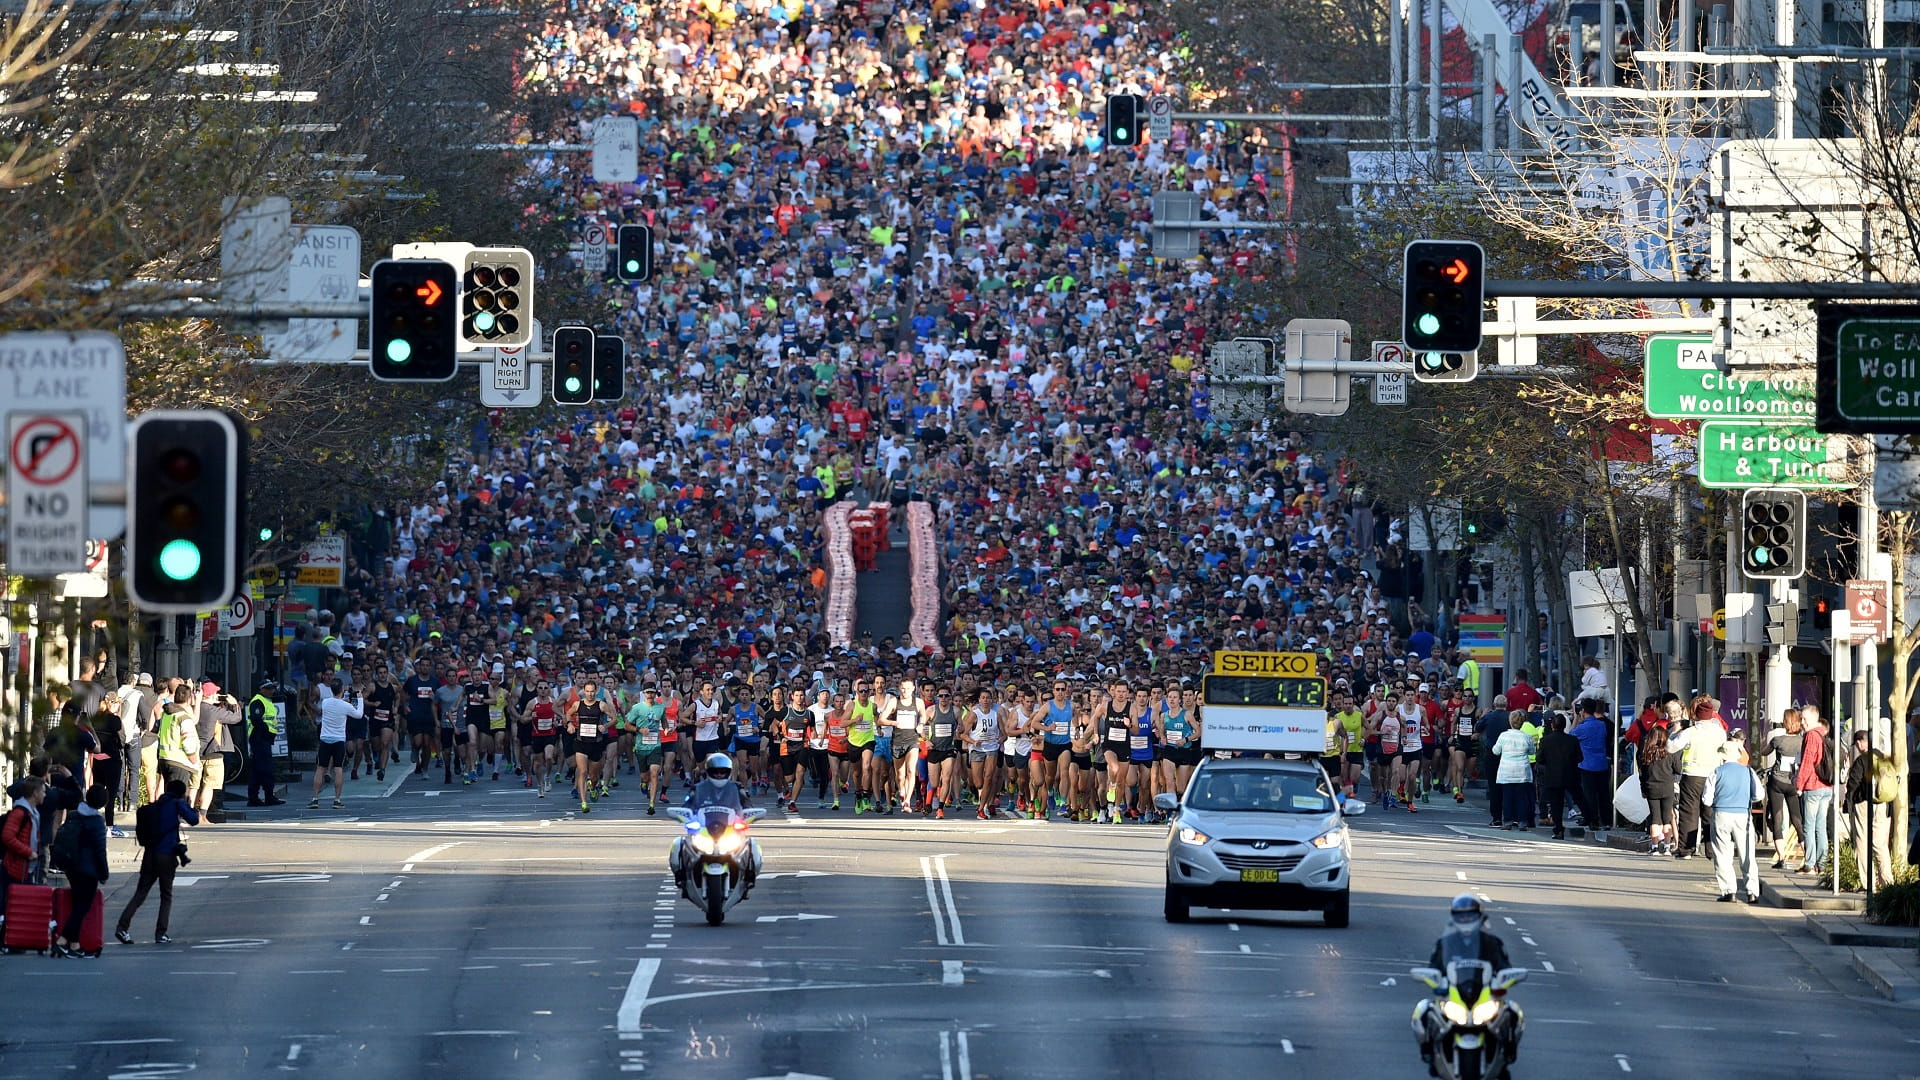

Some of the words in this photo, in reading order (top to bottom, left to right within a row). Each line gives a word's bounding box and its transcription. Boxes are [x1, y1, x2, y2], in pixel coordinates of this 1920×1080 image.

[289, 235, 352, 249] RANSIT
[1854, 333, 1881, 350] To
[501, 358, 518, 367] NO
[13, 376, 91, 398] LANE
[1383, 373, 1399, 383] NO
[1701, 372, 1748, 394] City
[1720, 431, 1824, 452] Harbour
[1735, 457, 1752, 476] &
[24, 490, 69, 518] NO
[15, 524, 77, 542] RIGHT
[19, 546, 78, 564] TURN
[1222, 654, 1309, 673] SEIKO
